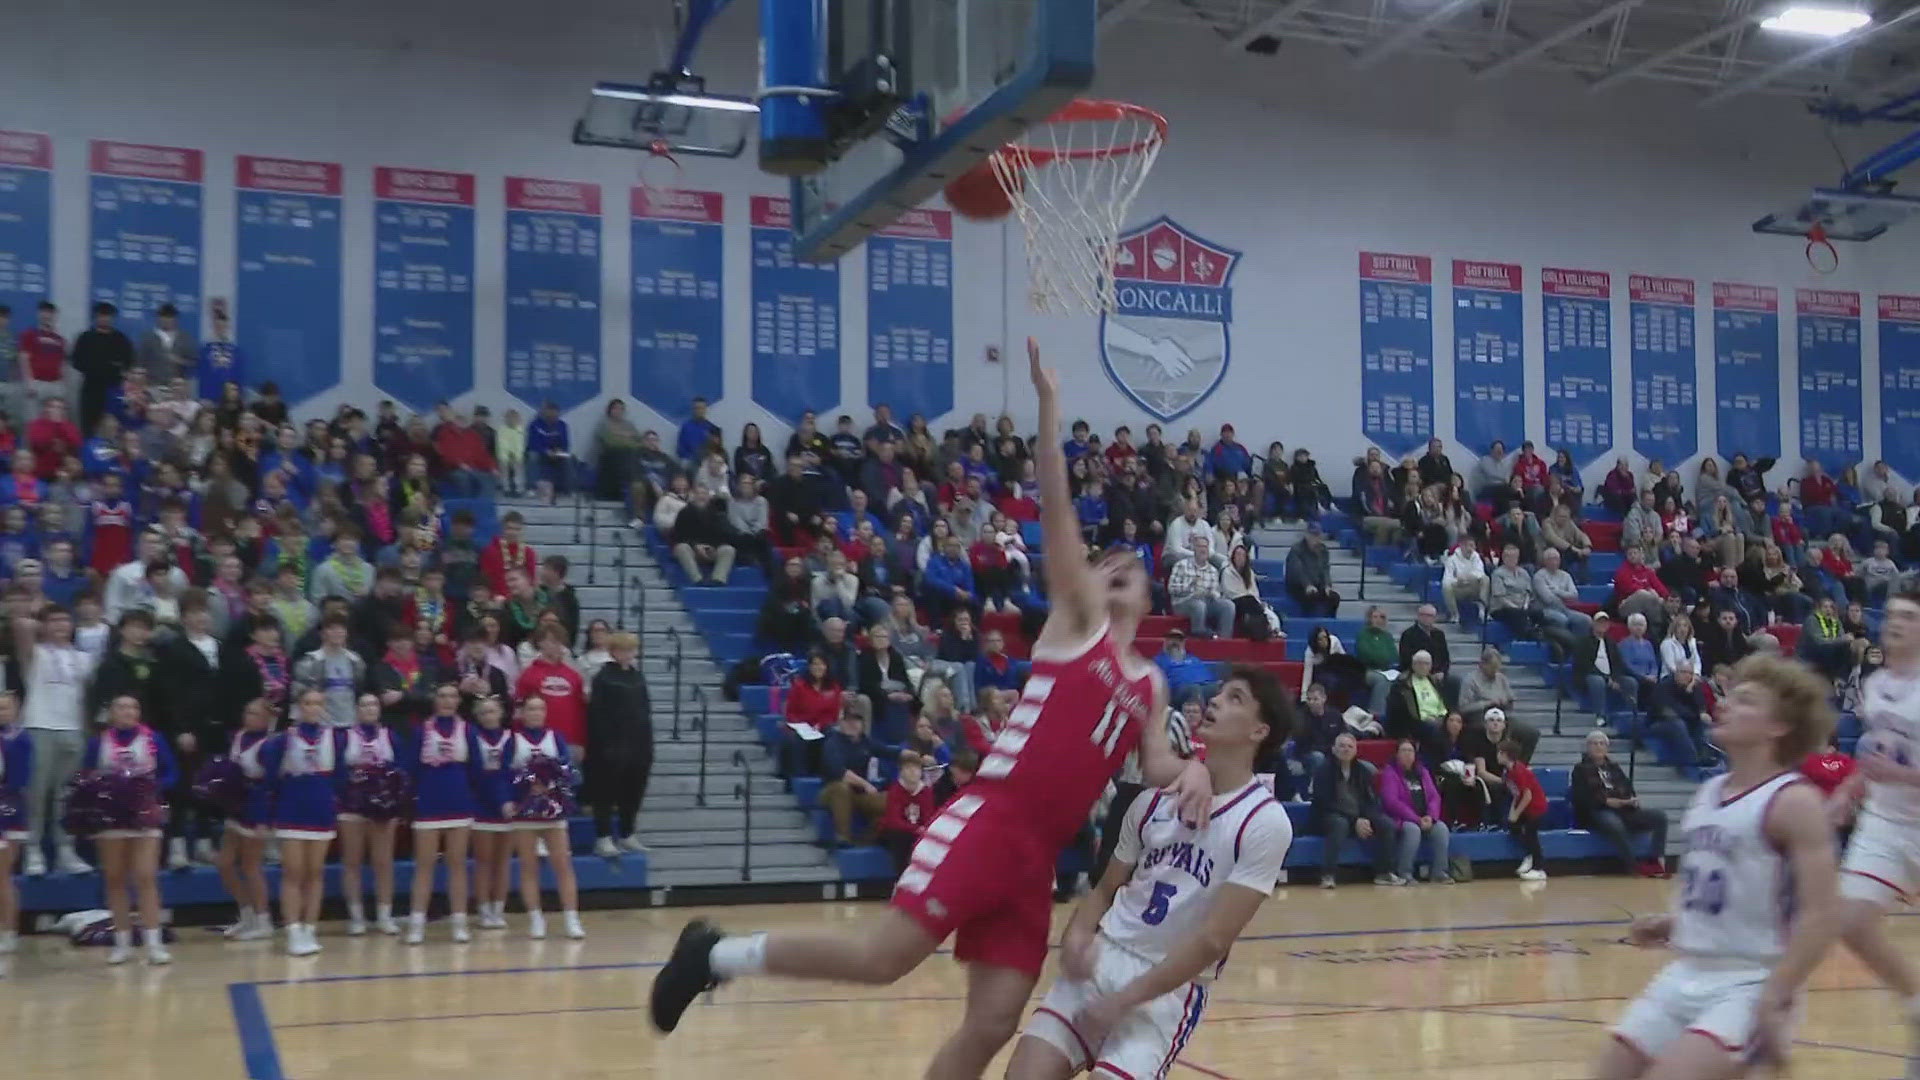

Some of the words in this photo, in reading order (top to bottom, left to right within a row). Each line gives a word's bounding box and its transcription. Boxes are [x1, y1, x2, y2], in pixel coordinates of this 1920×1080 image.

[1372, 256, 1417, 271] SOFTBALL
[1465, 263, 1509, 278] SOFTBALL
[1090, 699, 1130, 759] 11
[1143, 841, 1214, 888] ROYALS
[1141, 880, 1178, 926] 5
